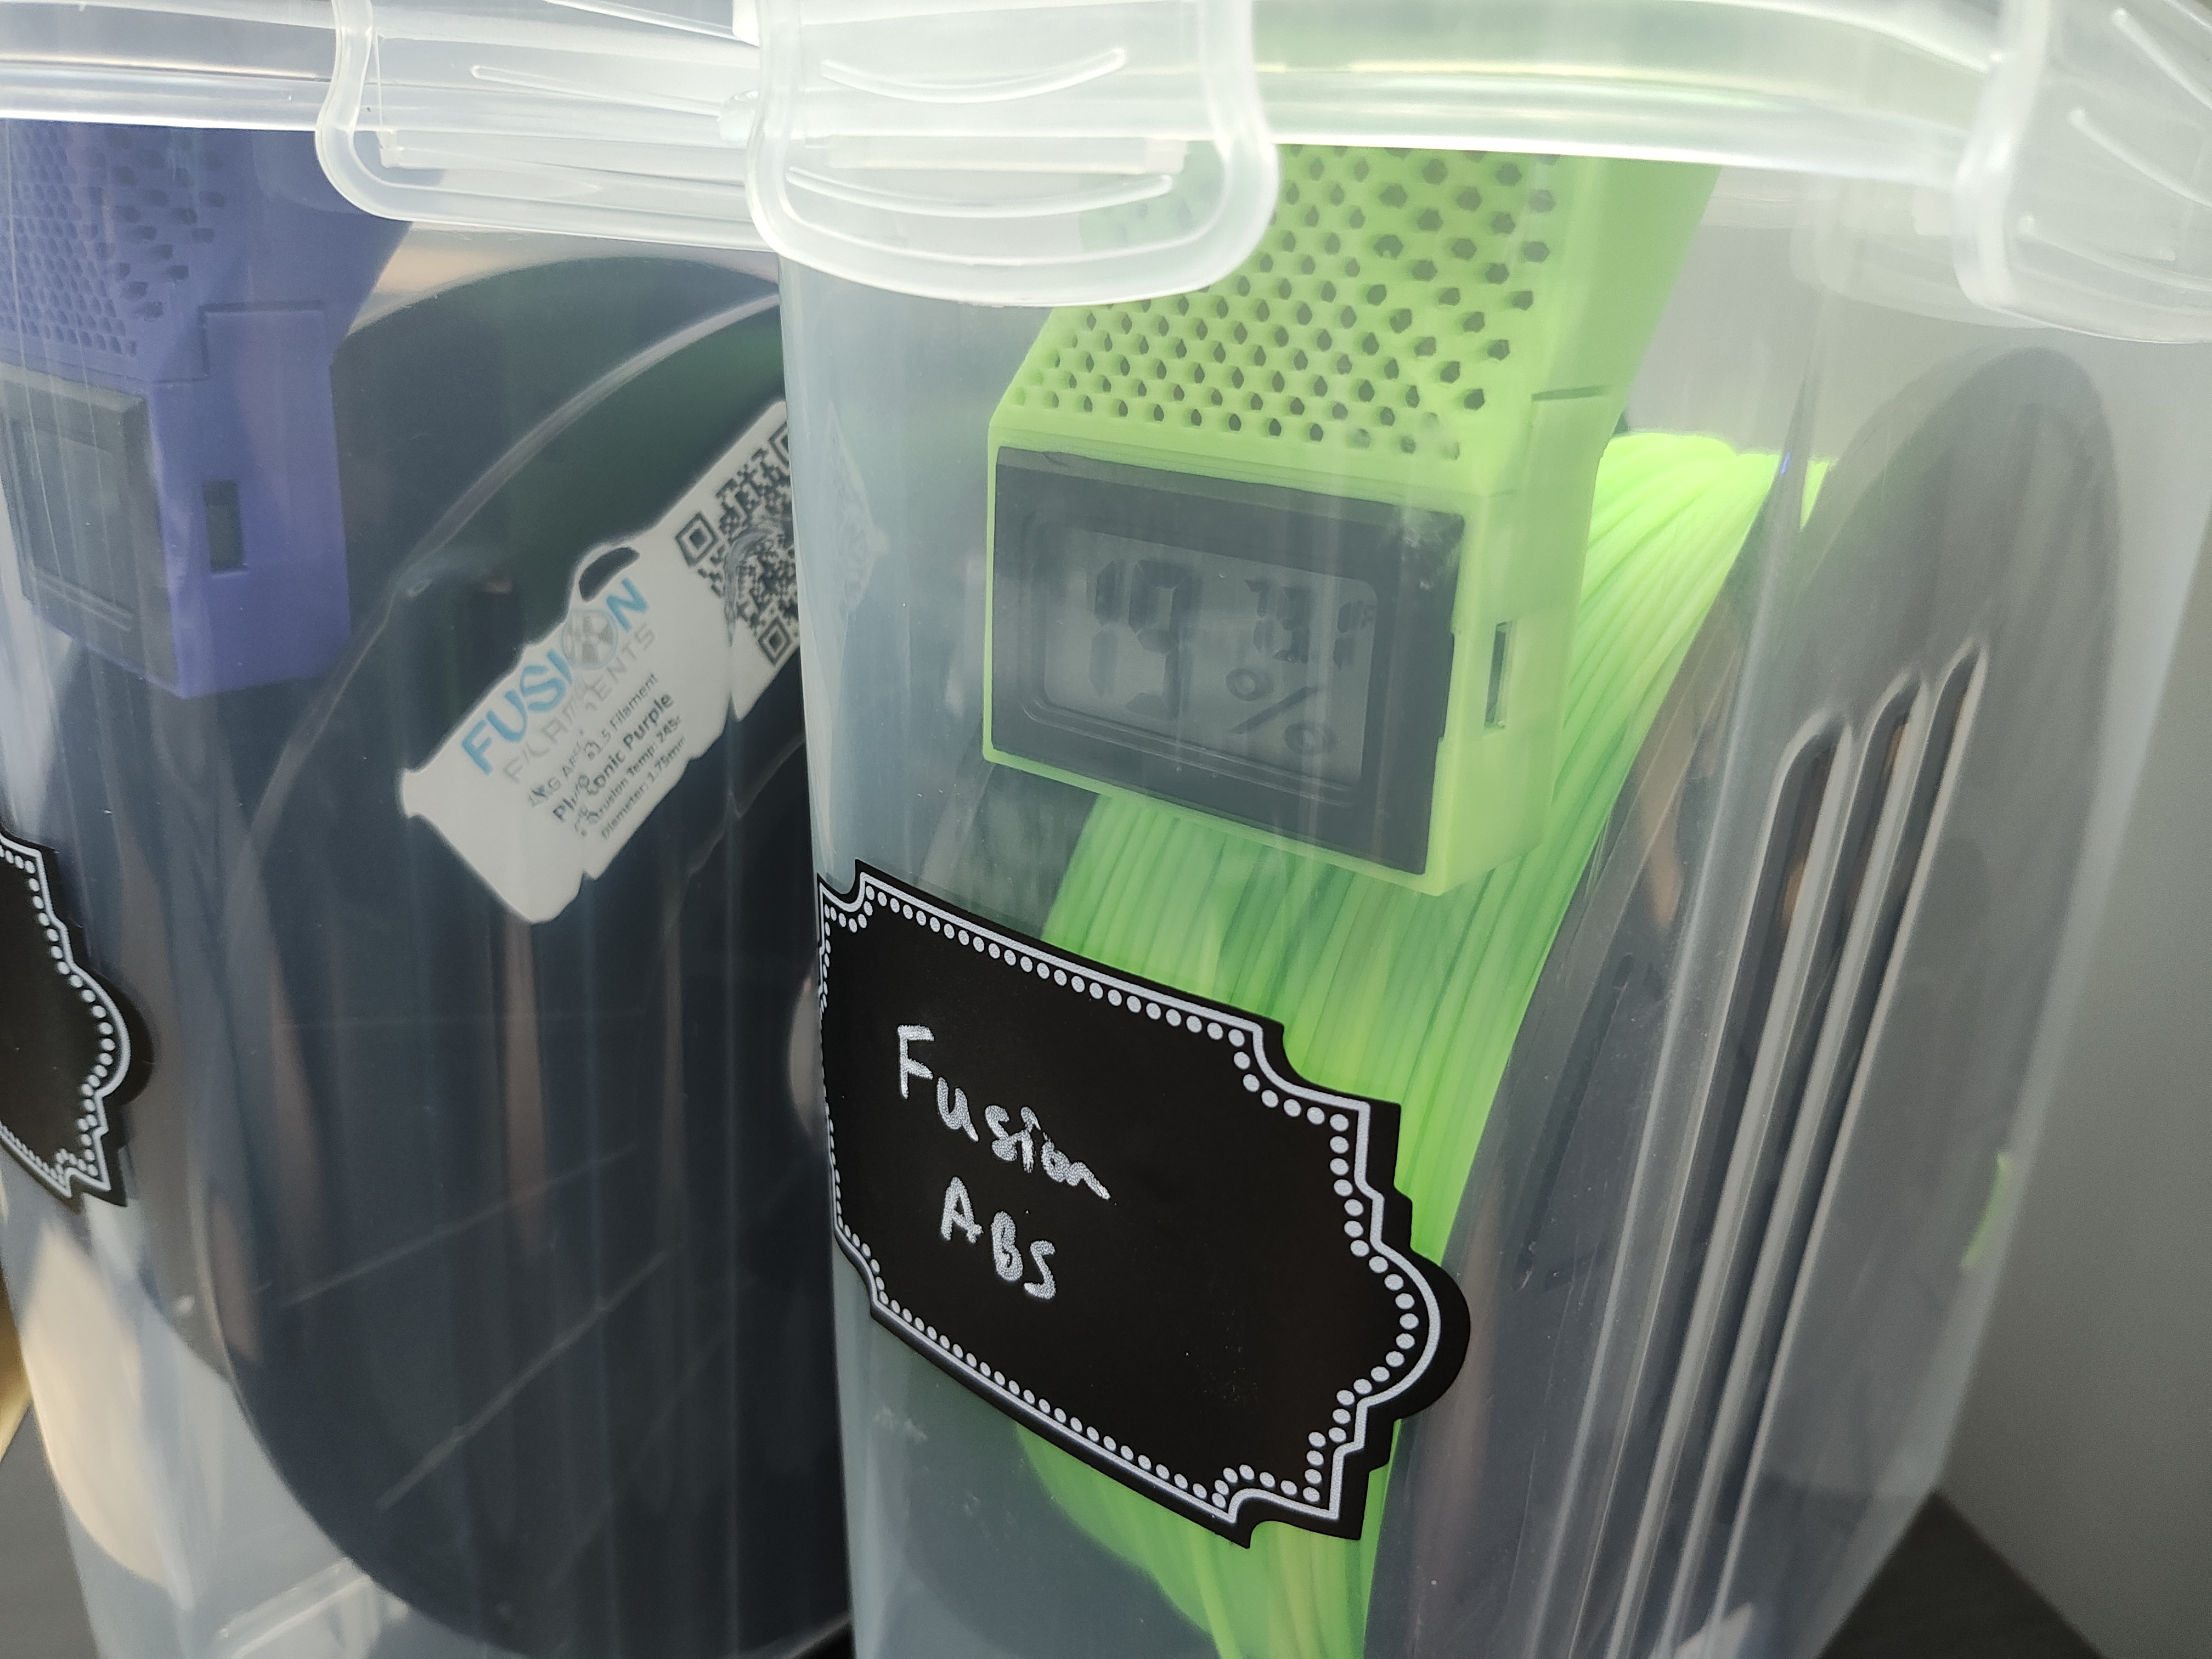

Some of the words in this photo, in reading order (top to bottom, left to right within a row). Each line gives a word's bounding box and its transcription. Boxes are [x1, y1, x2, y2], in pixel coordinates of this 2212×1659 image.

[461, 577, 649, 775] FUSION
[610, 673, 658, 731] Filament
[623, 694, 674, 750] Purple
[897, 1024, 1111, 1200] Fusion
[940, 1176, 1057, 1300] ABS
